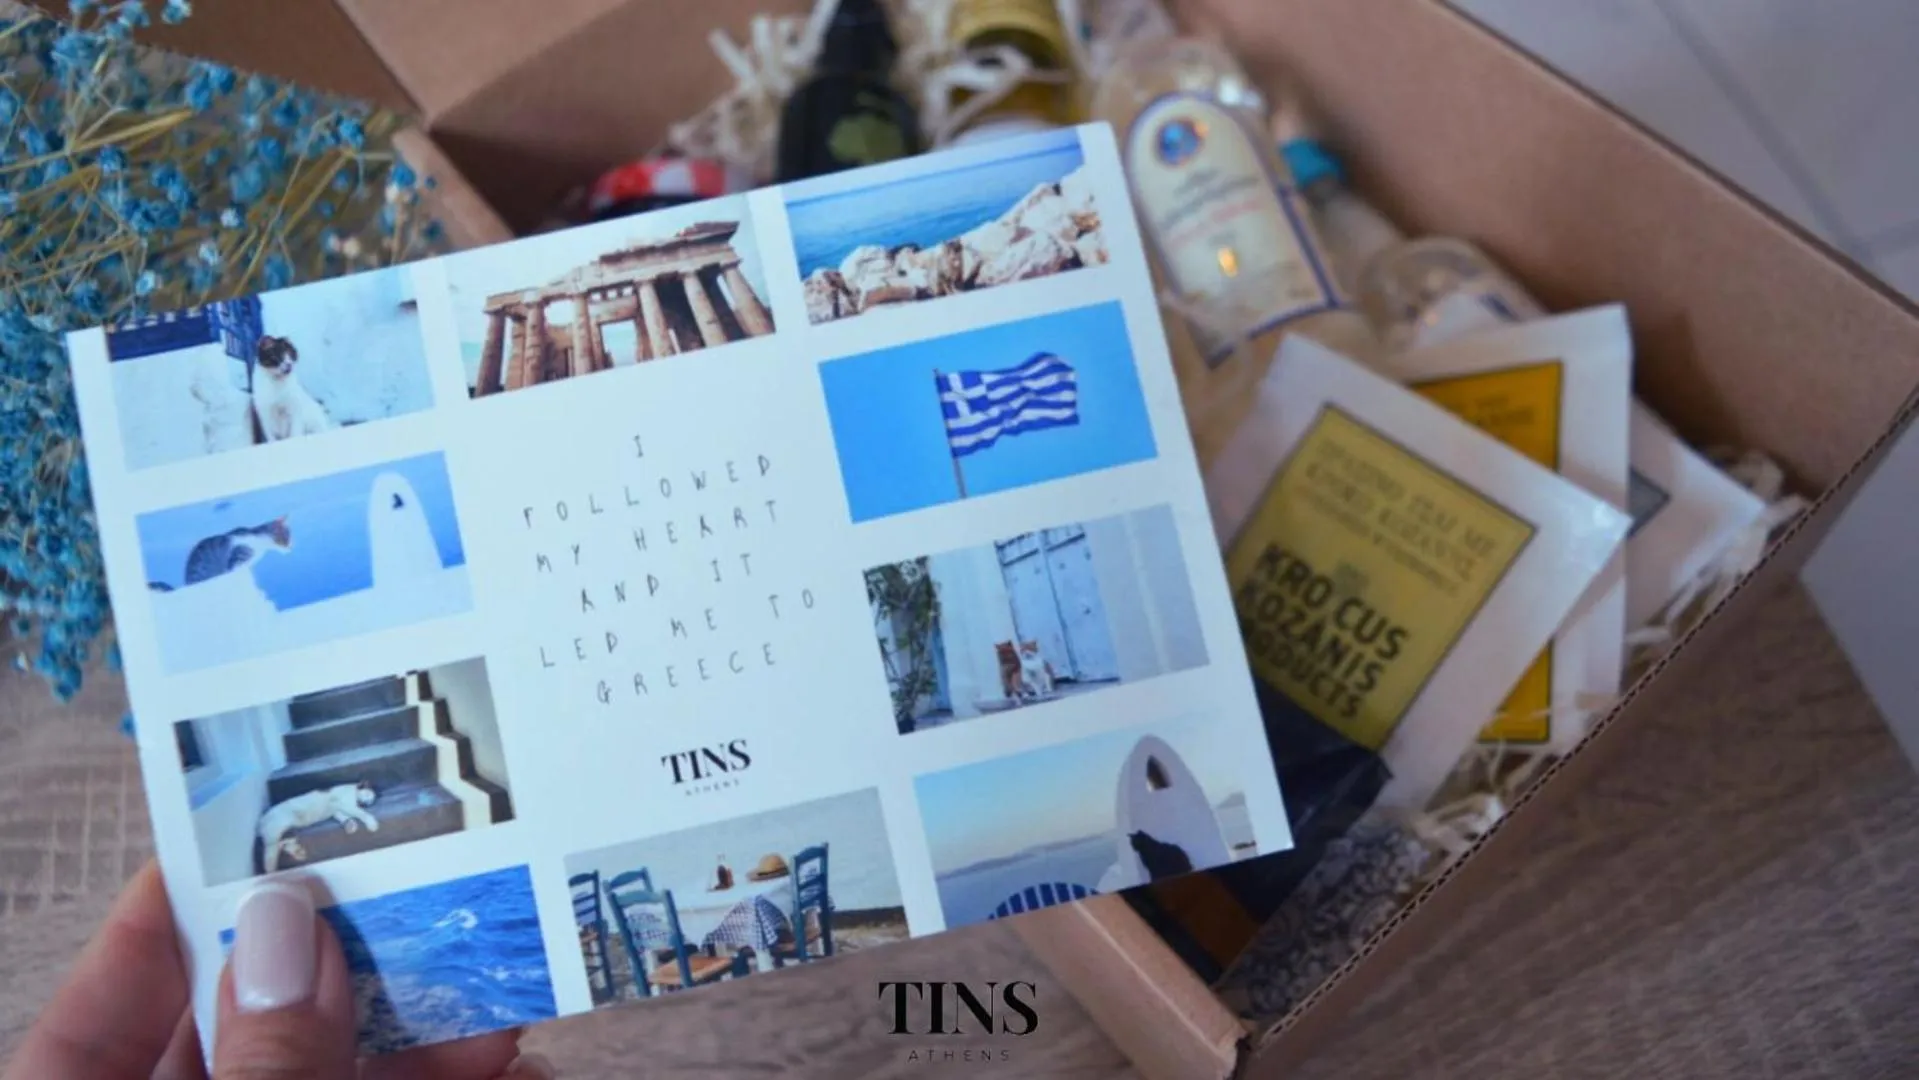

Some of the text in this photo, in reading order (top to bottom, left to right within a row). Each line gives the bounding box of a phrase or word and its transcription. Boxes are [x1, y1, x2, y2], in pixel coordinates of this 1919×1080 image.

[633, 434, 644, 458] I
[522, 454, 771, 529] FOLLOWED
[535, 499, 776, 573] MY HEART
[581, 553, 751, 613] AND IT
[539, 588, 815, 668] LED ME TO
[1237, 575, 1384, 694] KOZANIS
[596, 642, 776, 705] GREECE
[1242, 616, 1363, 721] RODUCTS
[660, 738, 752, 785] TINS
